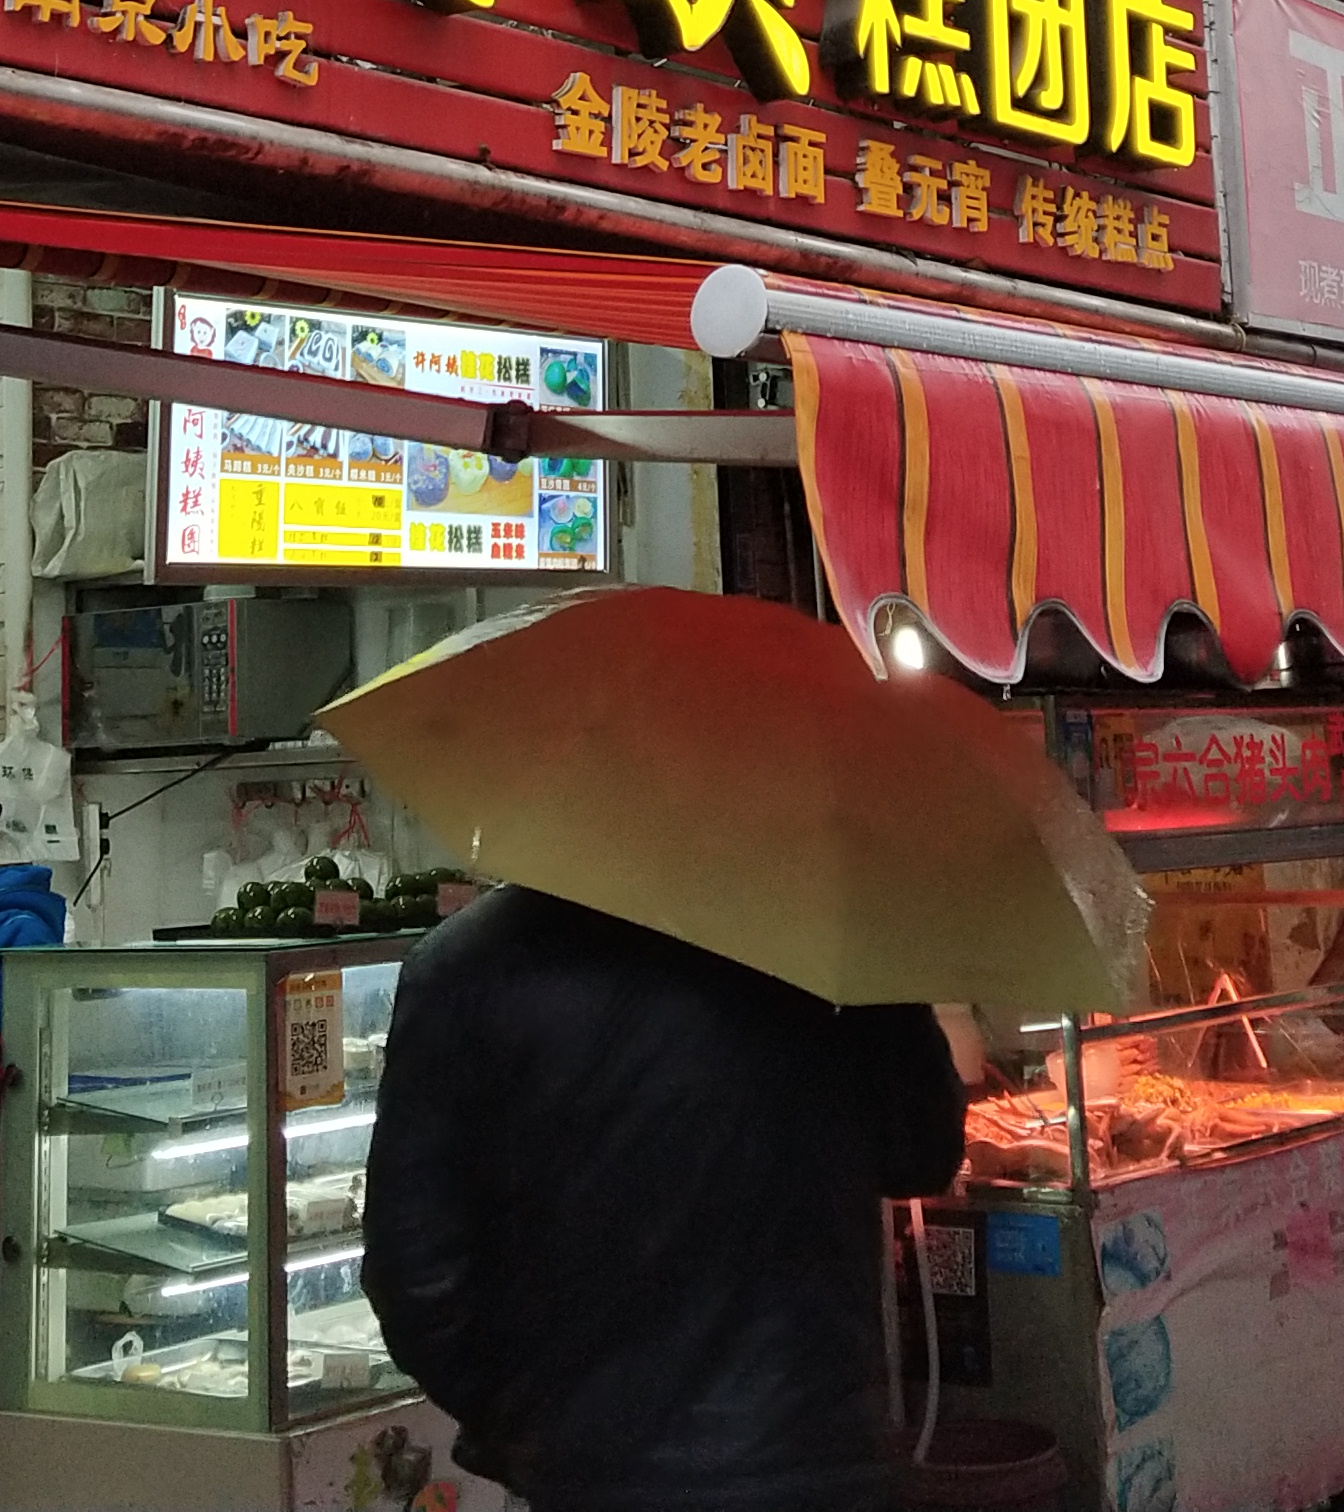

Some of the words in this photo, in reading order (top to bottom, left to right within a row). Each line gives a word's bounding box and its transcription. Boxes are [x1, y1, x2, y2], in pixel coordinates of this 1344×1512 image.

[552, 70, 827, 205] 金陵老卤面
[855, 139, 991, 232] 叠元宵
[1014, 173, 1174, 271] 传统糕点
